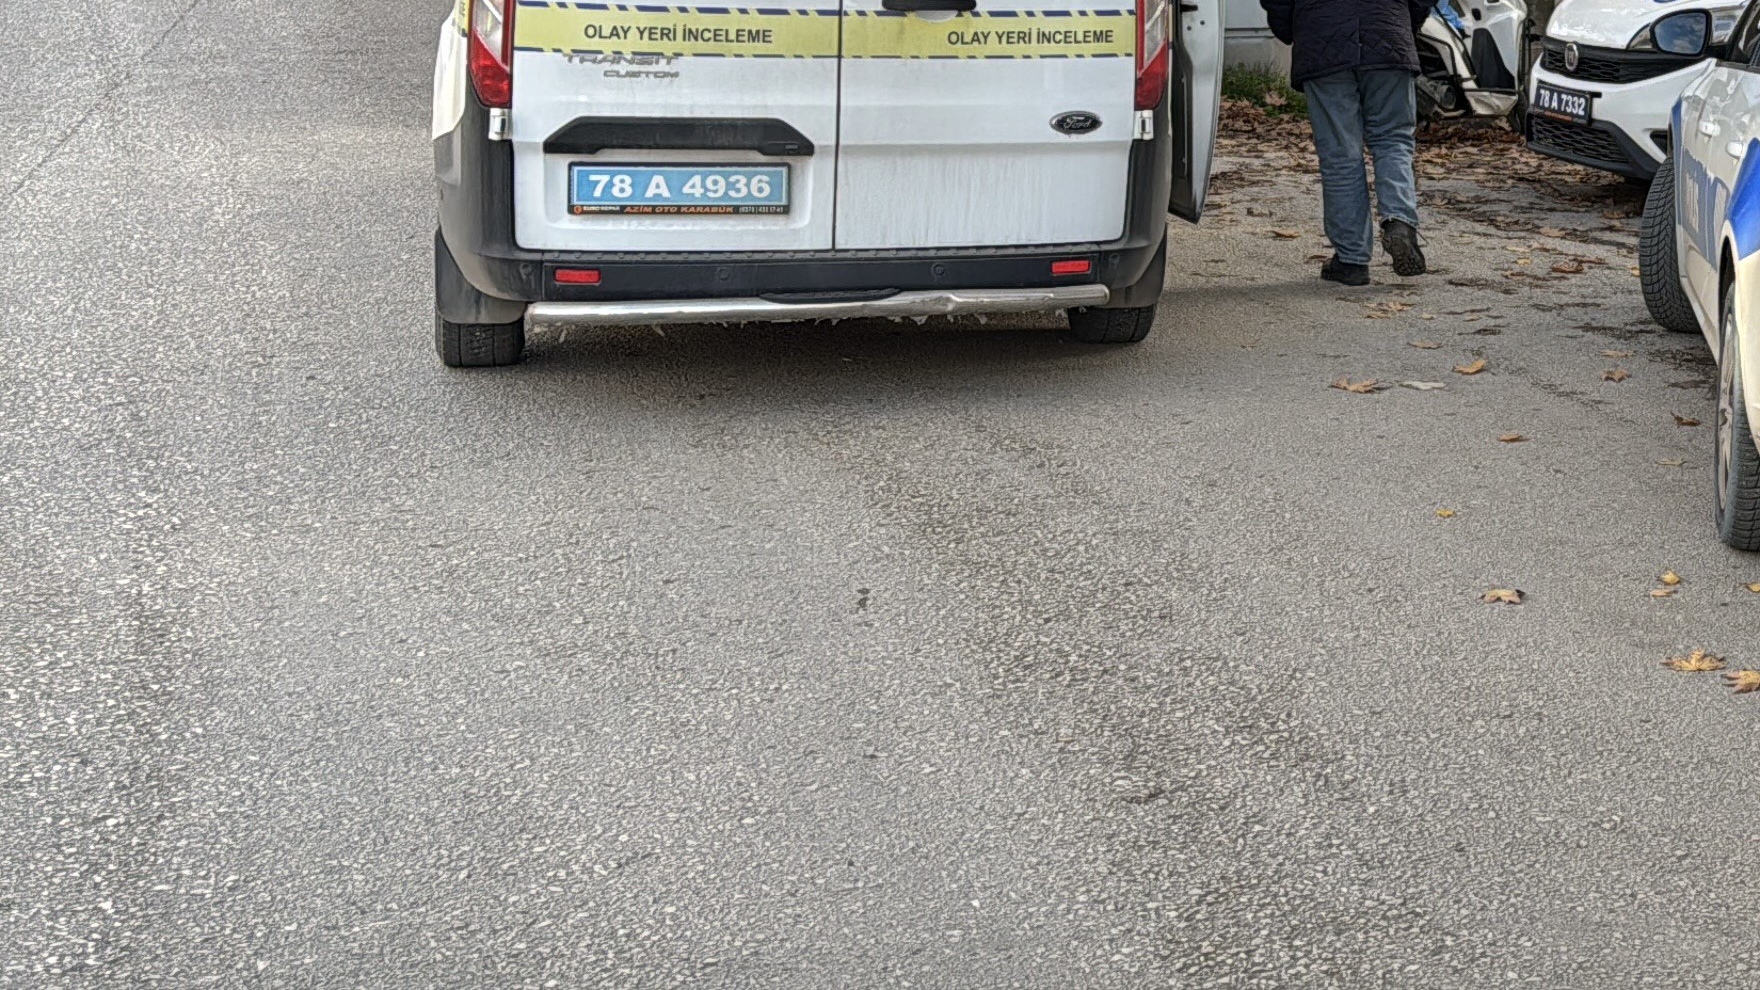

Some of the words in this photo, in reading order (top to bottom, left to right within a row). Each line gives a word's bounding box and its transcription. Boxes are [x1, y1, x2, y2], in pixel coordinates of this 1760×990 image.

[583, 23, 632, 41] OLAY
[635, 23, 677, 42] YERİ
[682, 23, 774, 44] İNCELEME
[947, 30, 992, 46] OLAY
[995, 28, 1032, 45] YERİ
[1036, 27, 1114, 45] İNCELEME
[603, 69, 680, 79] CUSTOM
[1539, 89, 1551, 108] 78
[1550, 92, 1558, 110] A
[1560, 93, 1586, 116] 7332
[588, 174, 634, 198] 78
[644, 174, 671, 198] A
[681, 174, 772, 198] 4936
